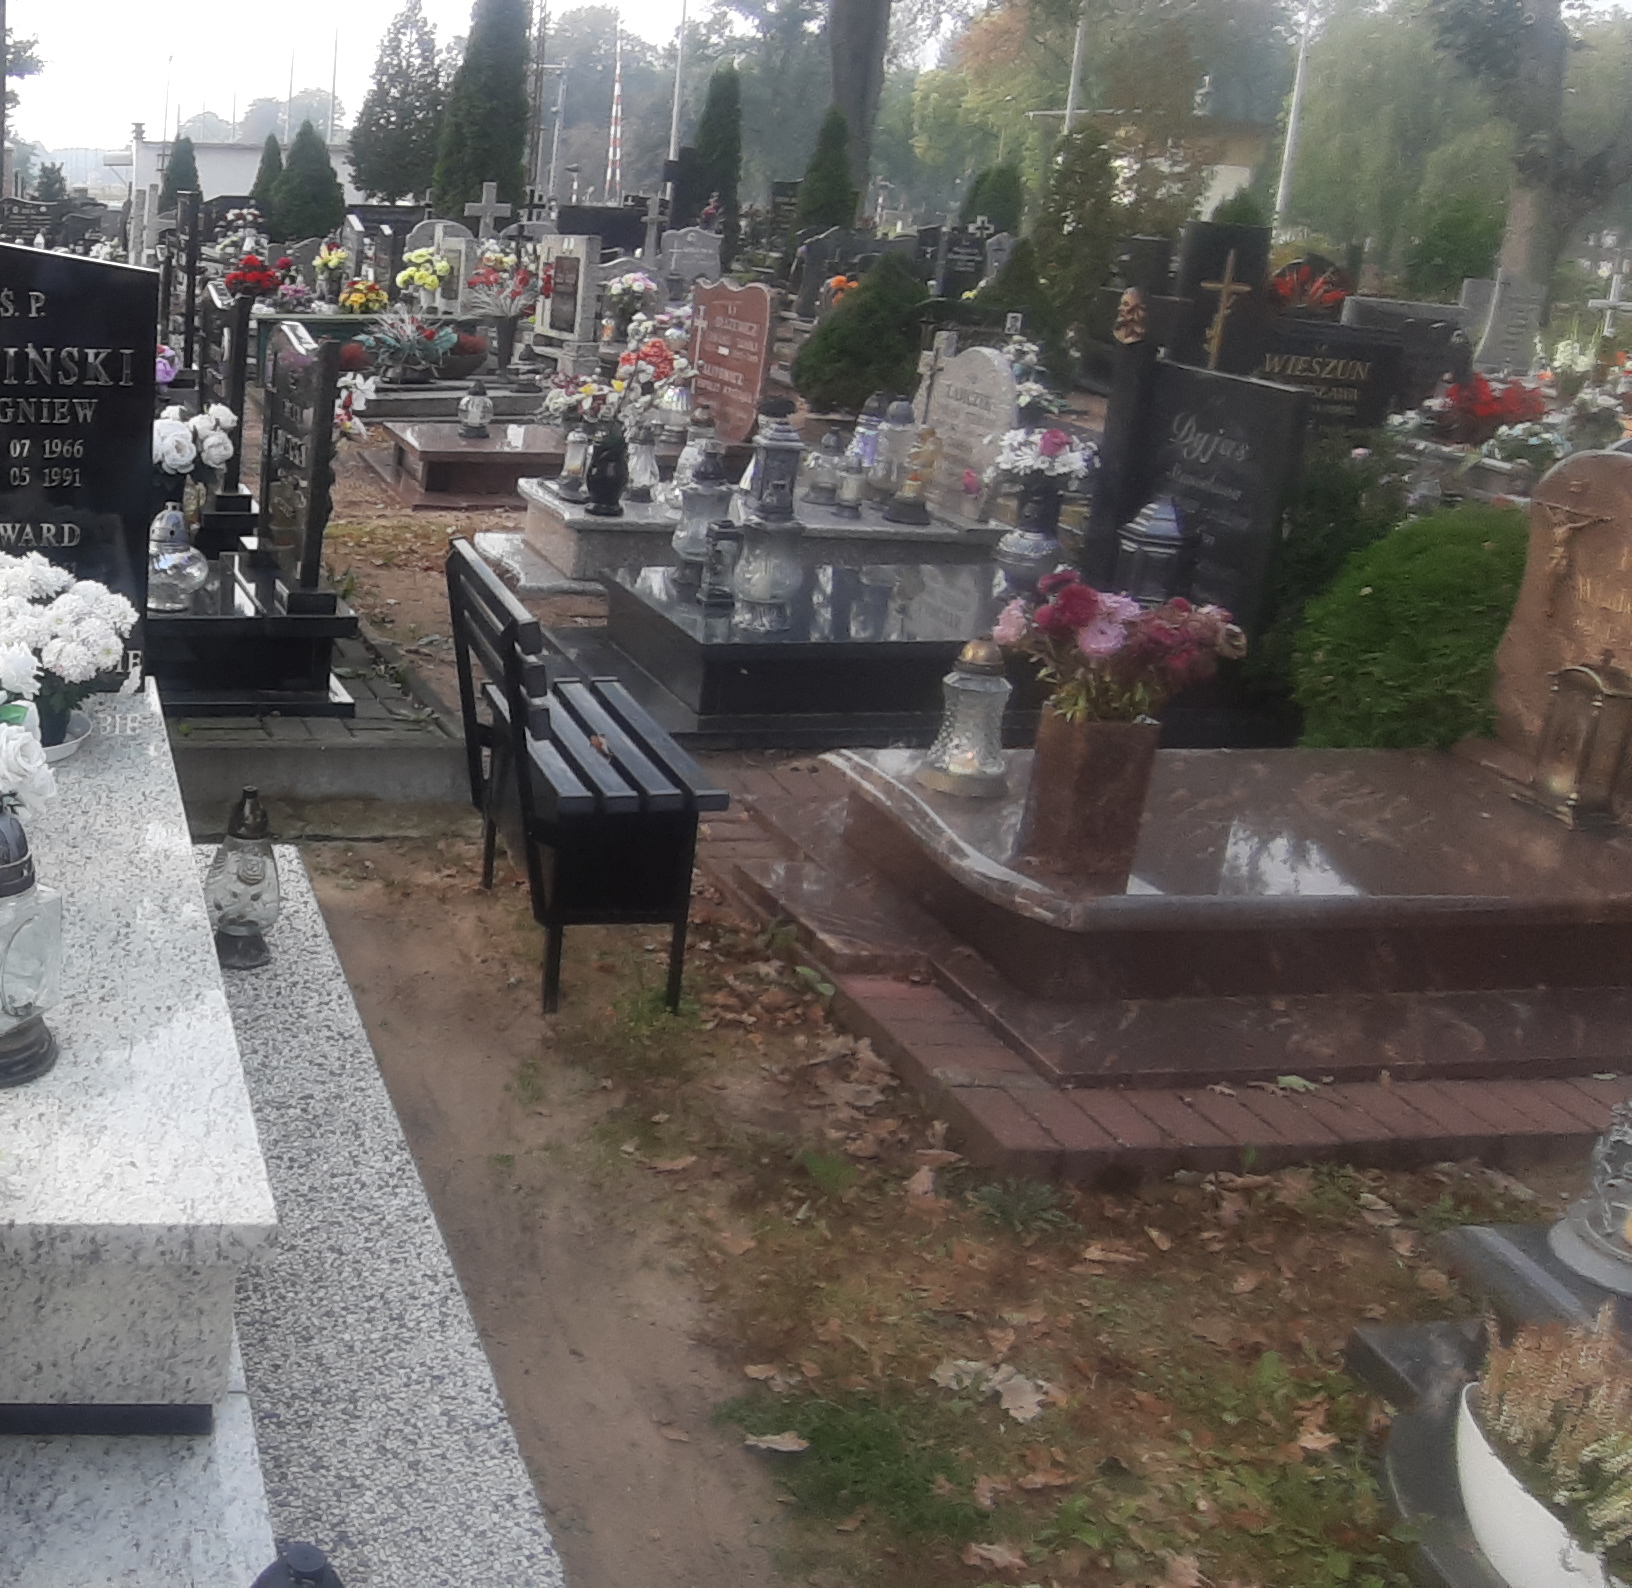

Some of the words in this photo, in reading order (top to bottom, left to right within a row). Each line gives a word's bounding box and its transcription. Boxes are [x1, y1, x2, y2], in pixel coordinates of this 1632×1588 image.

[28, 291, 46, 318] P.
[9, 438, 32, 458] 07
[43, 438, 85, 459] 1966
[9, 467, 31, 486] 05
[42, 467, 82, 487] 1991
